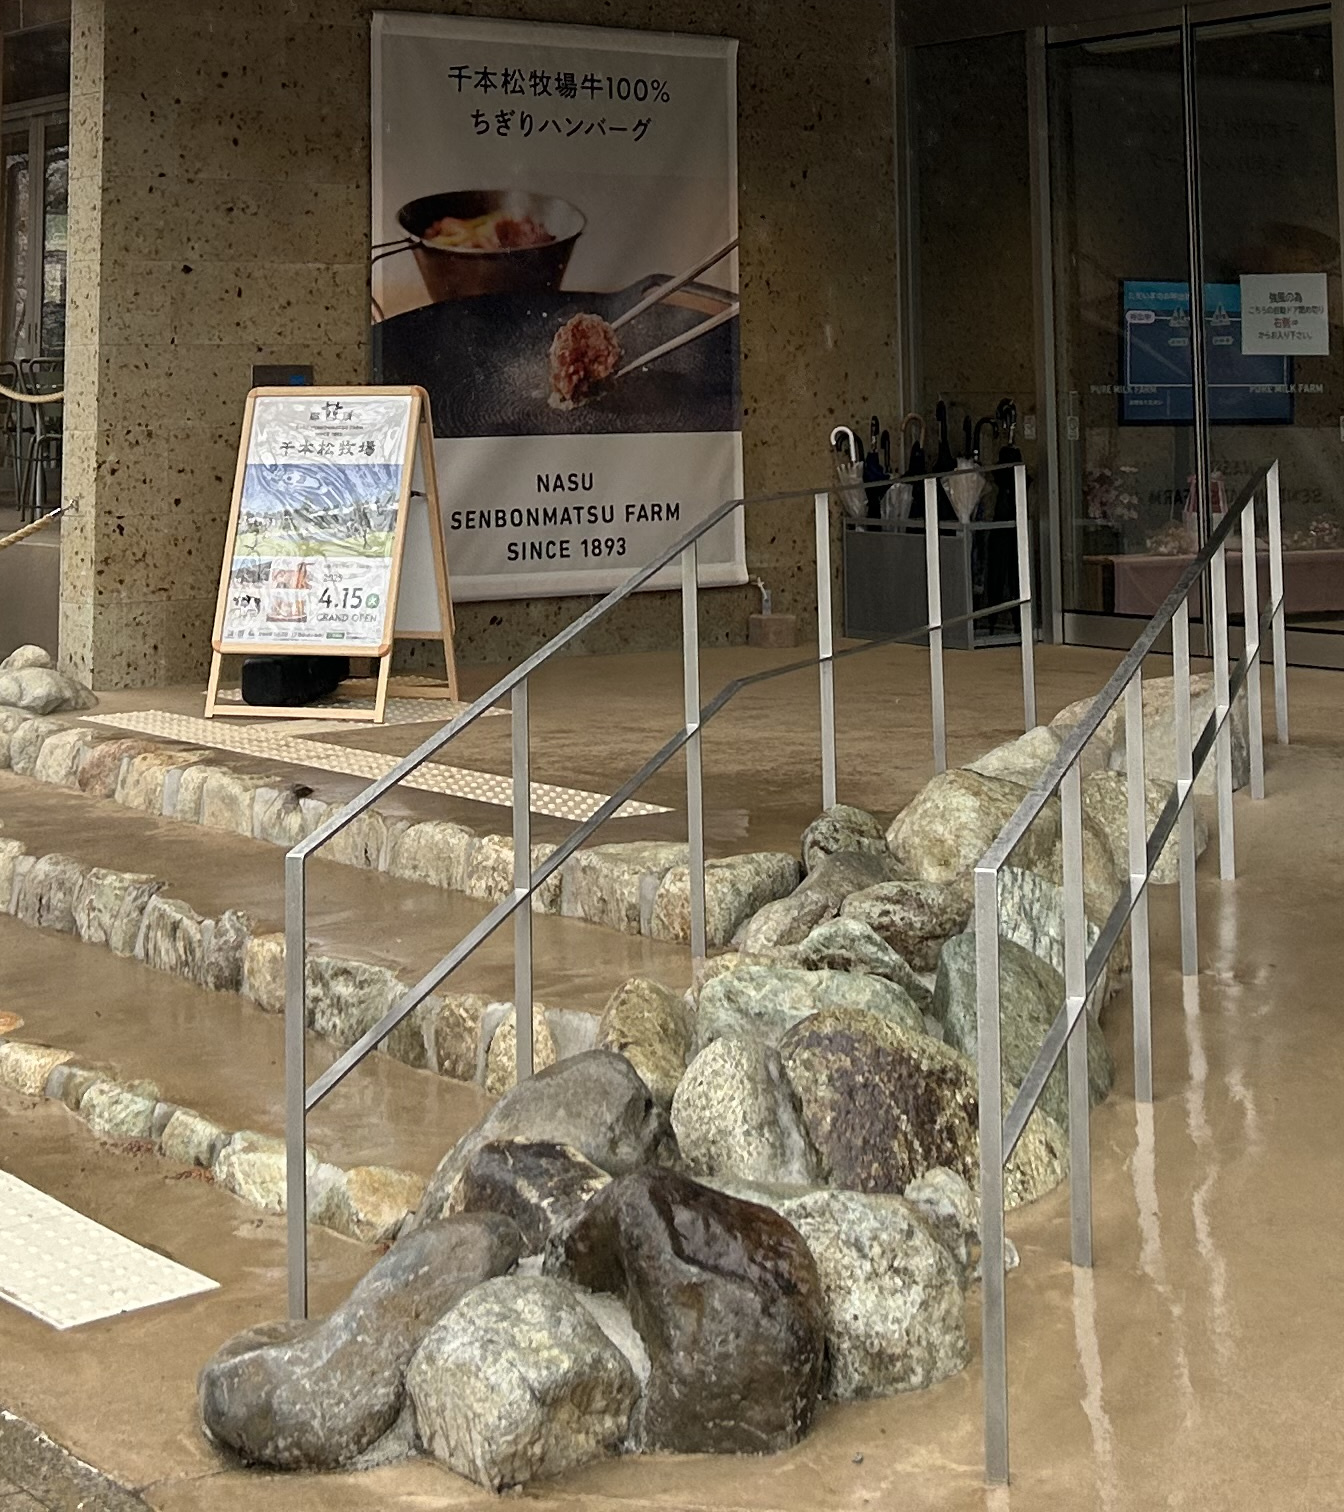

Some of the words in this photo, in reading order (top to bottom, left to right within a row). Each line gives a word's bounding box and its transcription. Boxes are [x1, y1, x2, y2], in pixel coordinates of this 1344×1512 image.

[447, 64, 671, 104] 千本松牧場牛100%
[471, 108, 653, 142] ちぎりハンバーグ
[1298, 383, 1324, 394] FARM
[279, 439, 376, 457] 千本松牧場
[536, 471, 594, 493] NASU
[450, 504, 615, 531] SENBONMATSU
[625, 502, 681, 523] FARM
[507, 539, 571, 561] SINCE
[580, 537, 627, 558] 1893
[318, 587, 364, 610] 4.15
[316, 613, 349, 623] GRAND
[351, 613, 377, 623] OPEN
